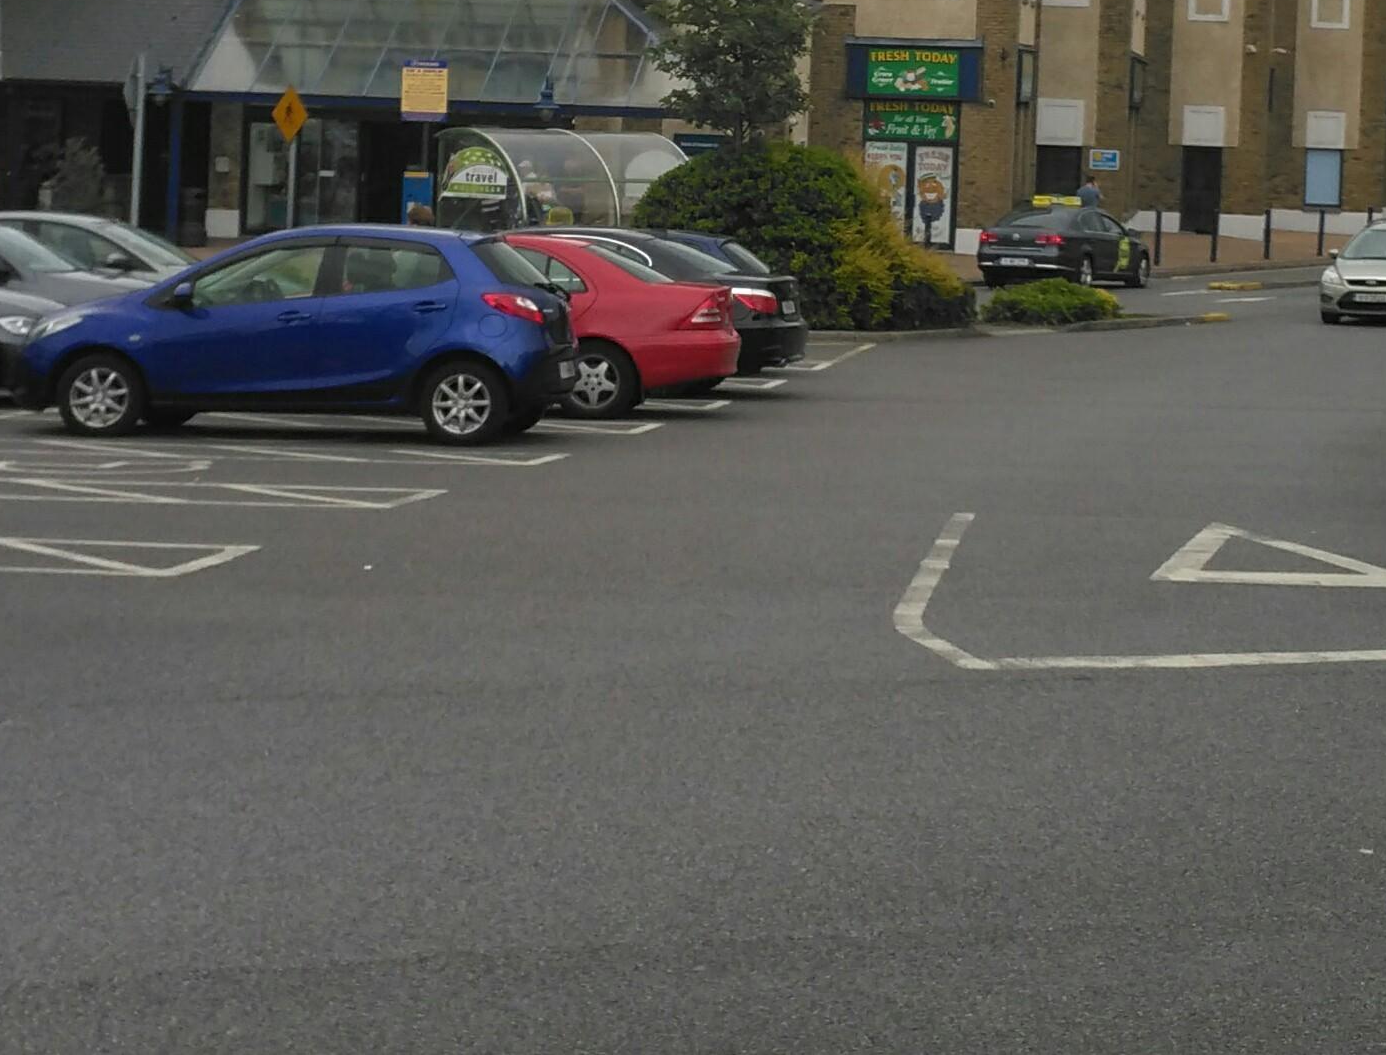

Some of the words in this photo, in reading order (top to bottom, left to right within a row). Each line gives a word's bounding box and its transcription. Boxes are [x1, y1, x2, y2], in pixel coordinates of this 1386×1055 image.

[871, 51, 909, 62] FRESH
[915, 51, 957, 64] TODAY
[465, 171, 497, 183] travel
